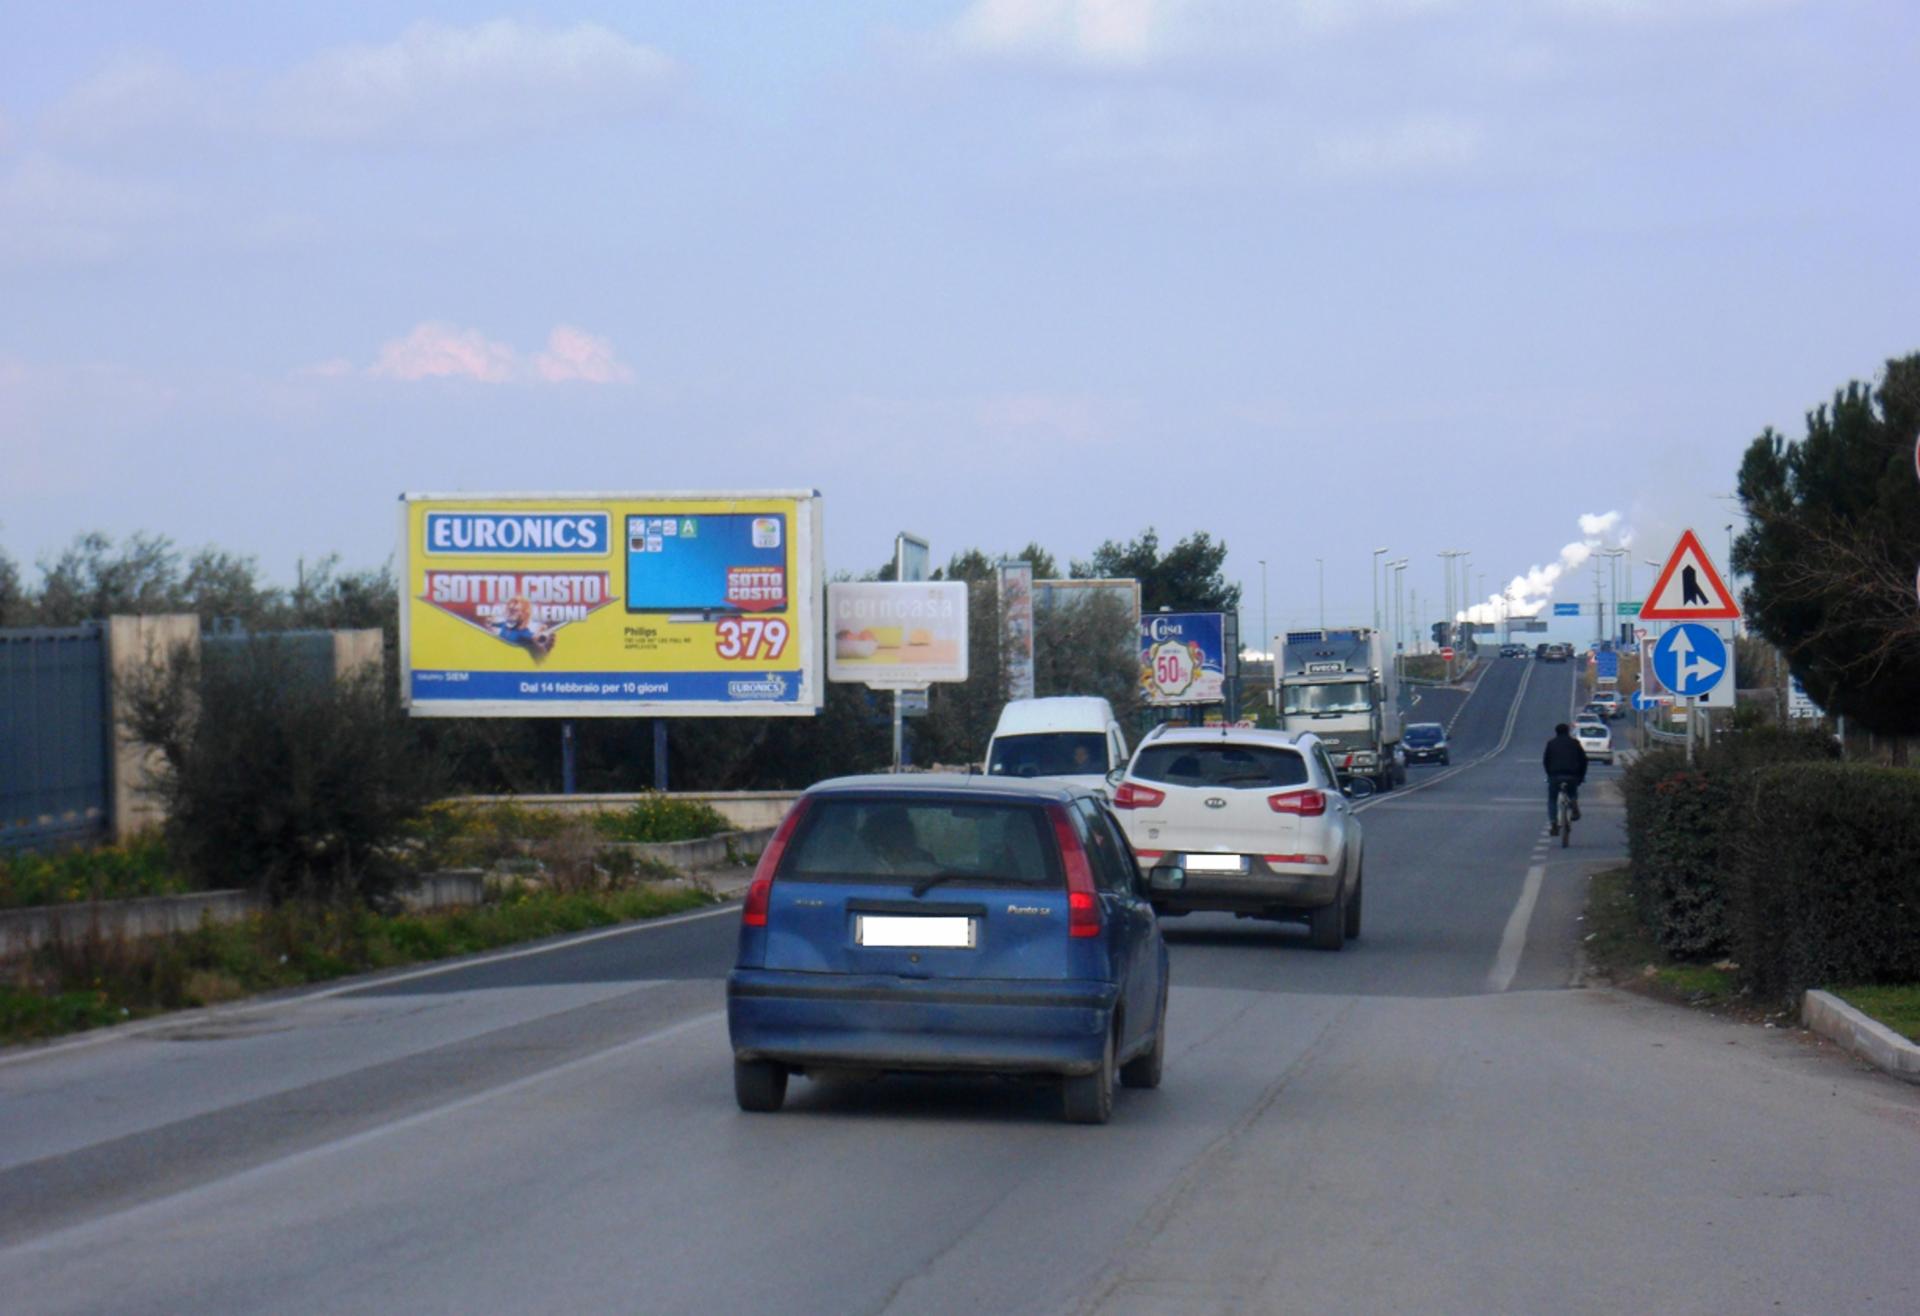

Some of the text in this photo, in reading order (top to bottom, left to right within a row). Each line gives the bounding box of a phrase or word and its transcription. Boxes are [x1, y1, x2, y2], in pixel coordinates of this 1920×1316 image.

[434, 518, 597, 548] EURONICS
[728, 573, 783, 586] SOTTO
[433, 574, 602, 605] SOTTO COSTO
[728, 587, 783, 600] COSTO
[840, 600, 953, 618] coincasa
[624, 627, 657, 638] Philips
[1150, 617, 1184, 641] Casa
[717, 618, 788, 660] 379
[520, 682, 669, 694] Dal 14 febbraio per 10 giorni
[731, 683, 780, 693] EURONICS
[1007, 905, 1038, 914] Punto
